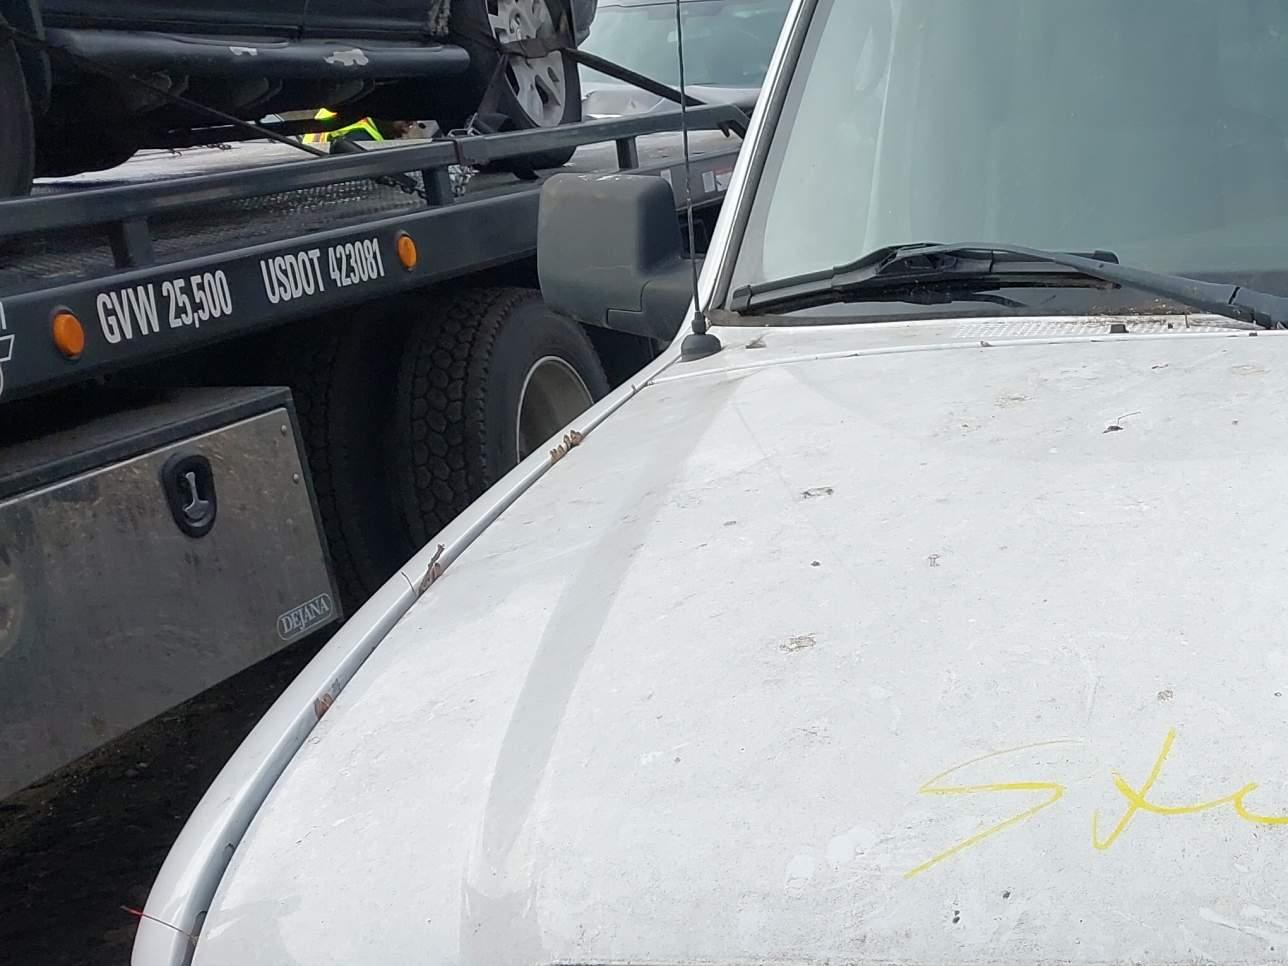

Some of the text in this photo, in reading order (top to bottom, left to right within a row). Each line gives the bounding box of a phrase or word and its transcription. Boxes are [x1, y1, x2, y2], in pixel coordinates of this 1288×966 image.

[260, 237, 385, 304] USDOT 423081
[97, 270, 233, 344] GVW 25,500
[281, 597, 330, 633] DEJANA
